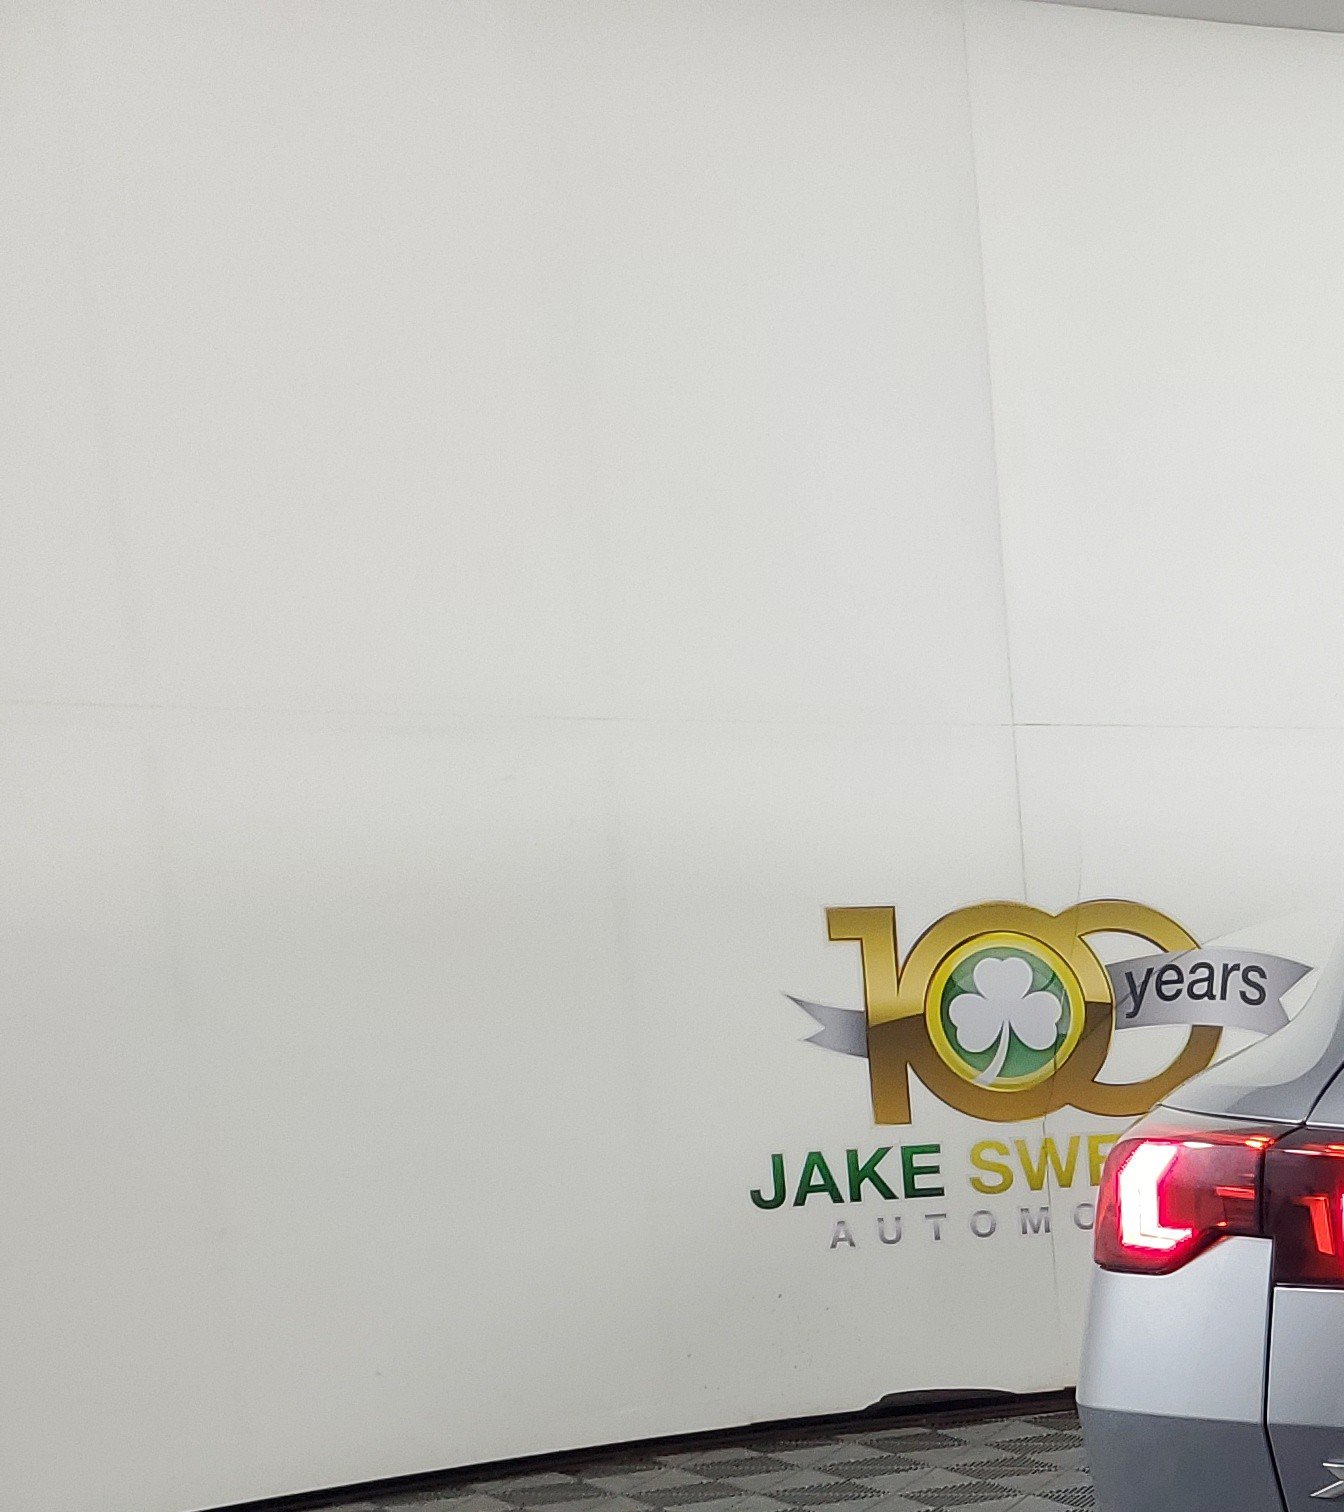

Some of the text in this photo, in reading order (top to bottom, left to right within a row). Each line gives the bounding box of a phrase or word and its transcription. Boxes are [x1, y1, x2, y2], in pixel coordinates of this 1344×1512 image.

[1124, 961, 1267, 1019] years
[749, 1143, 945, 1210] JAKE
[829, 1201, 1094, 1250] AUTOMO
